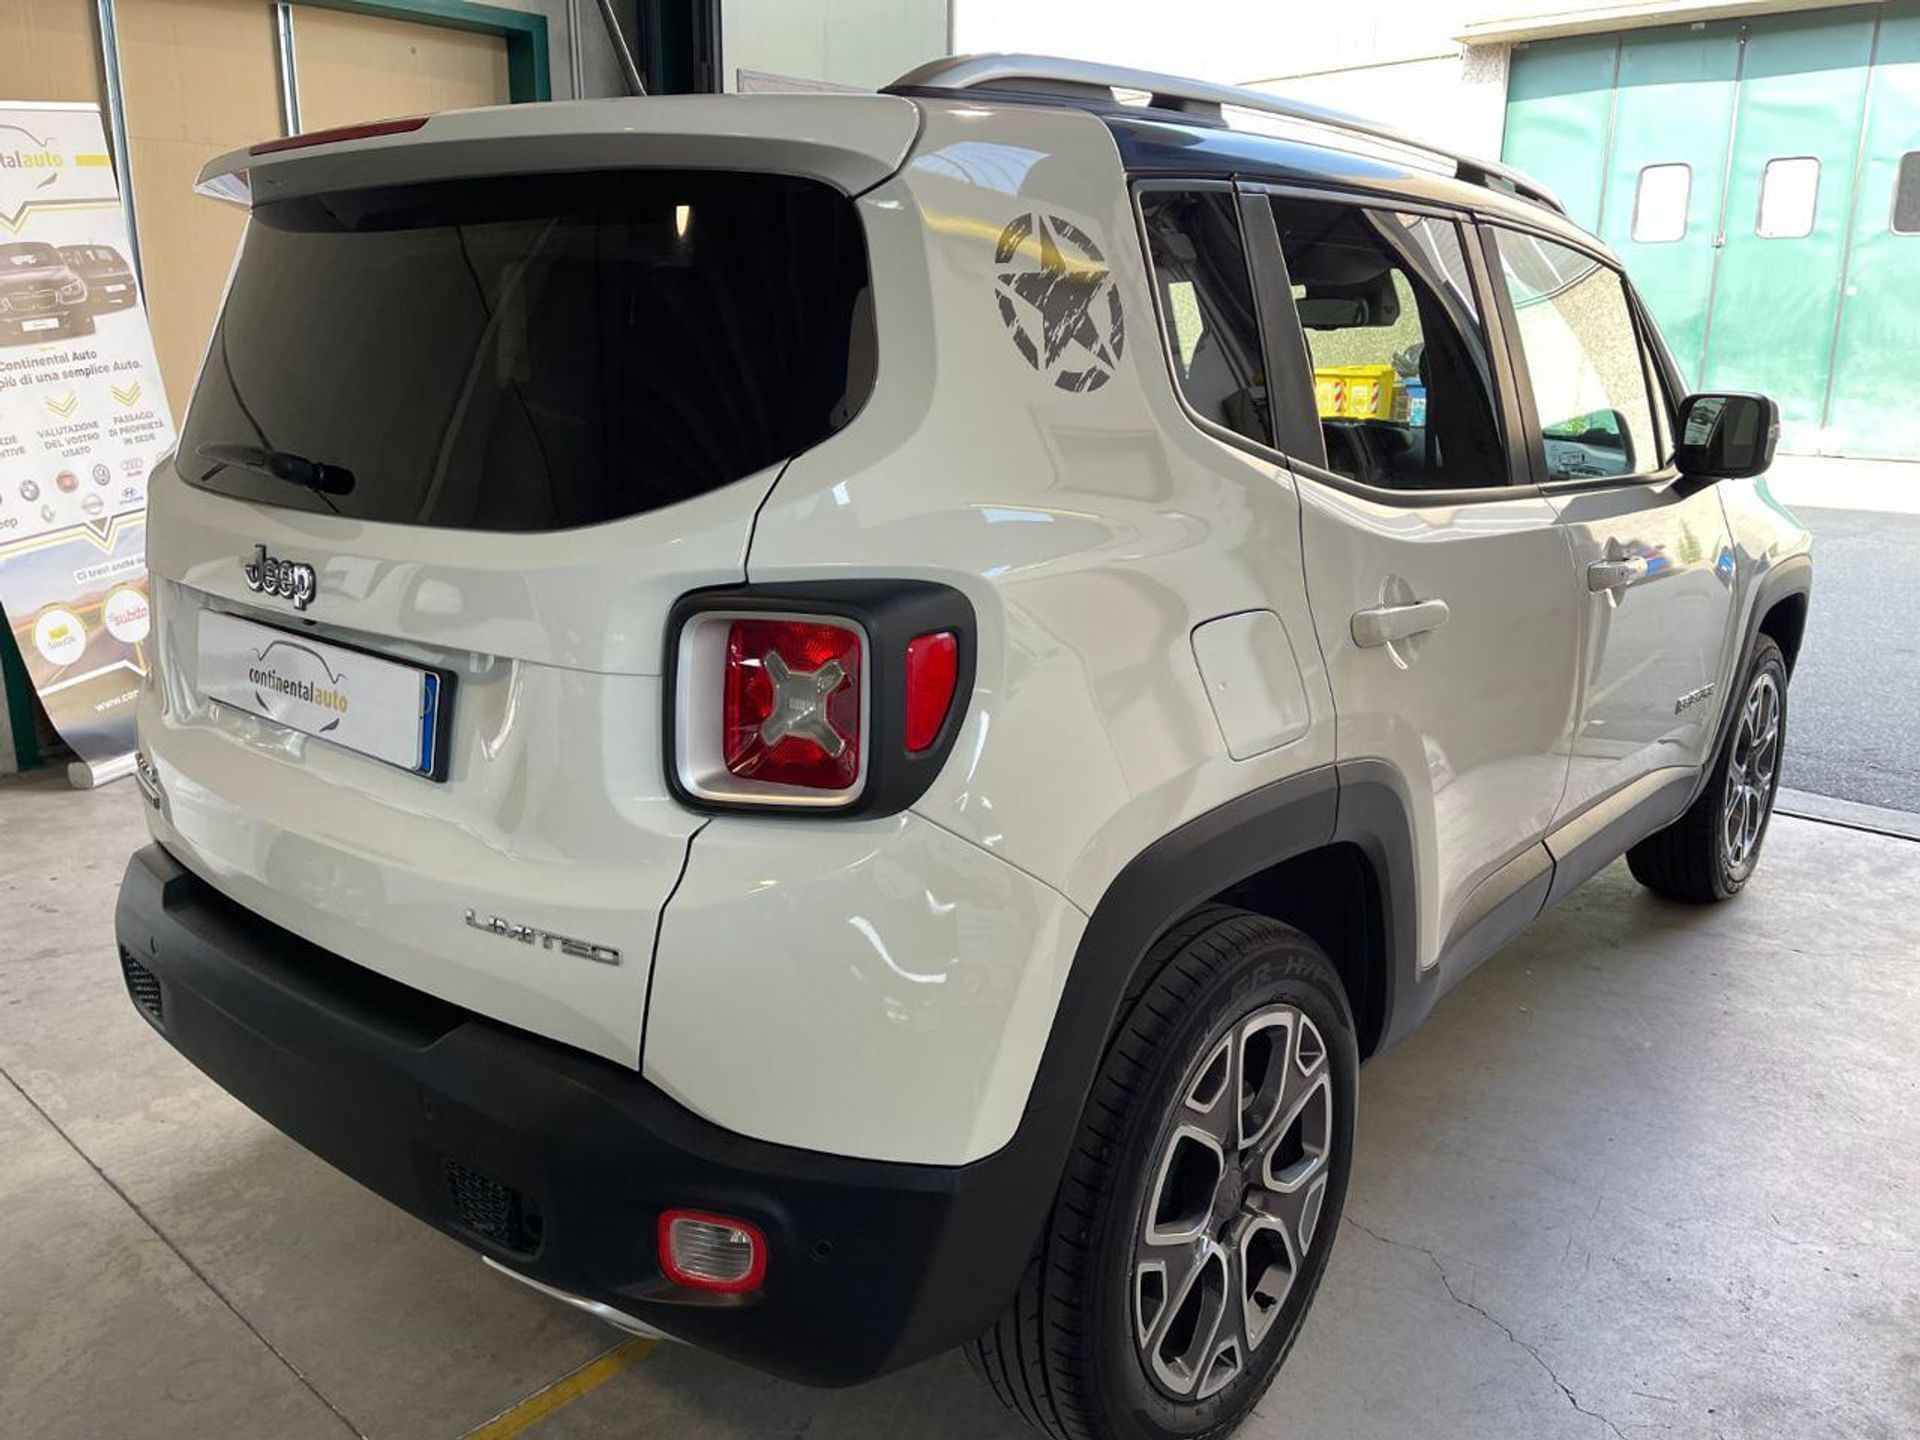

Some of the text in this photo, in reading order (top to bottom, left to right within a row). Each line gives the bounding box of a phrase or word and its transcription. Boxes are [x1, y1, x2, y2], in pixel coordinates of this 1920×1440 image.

[72, 350, 97, 361] Auto
[20, 373, 33, 385] di
[36, 371, 60, 383] una
[62, 363, 110, 379] semplice
[37, 421, 100, 438] VALUTAZIONE
[44, 432, 100, 450] DEL VOSTRO
[62, 446, 91, 458] USATO
[245, 543, 317, 612] Jeep
[249, 666, 349, 714] continentalauto
[465, 908, 624, 967] LIMITED
